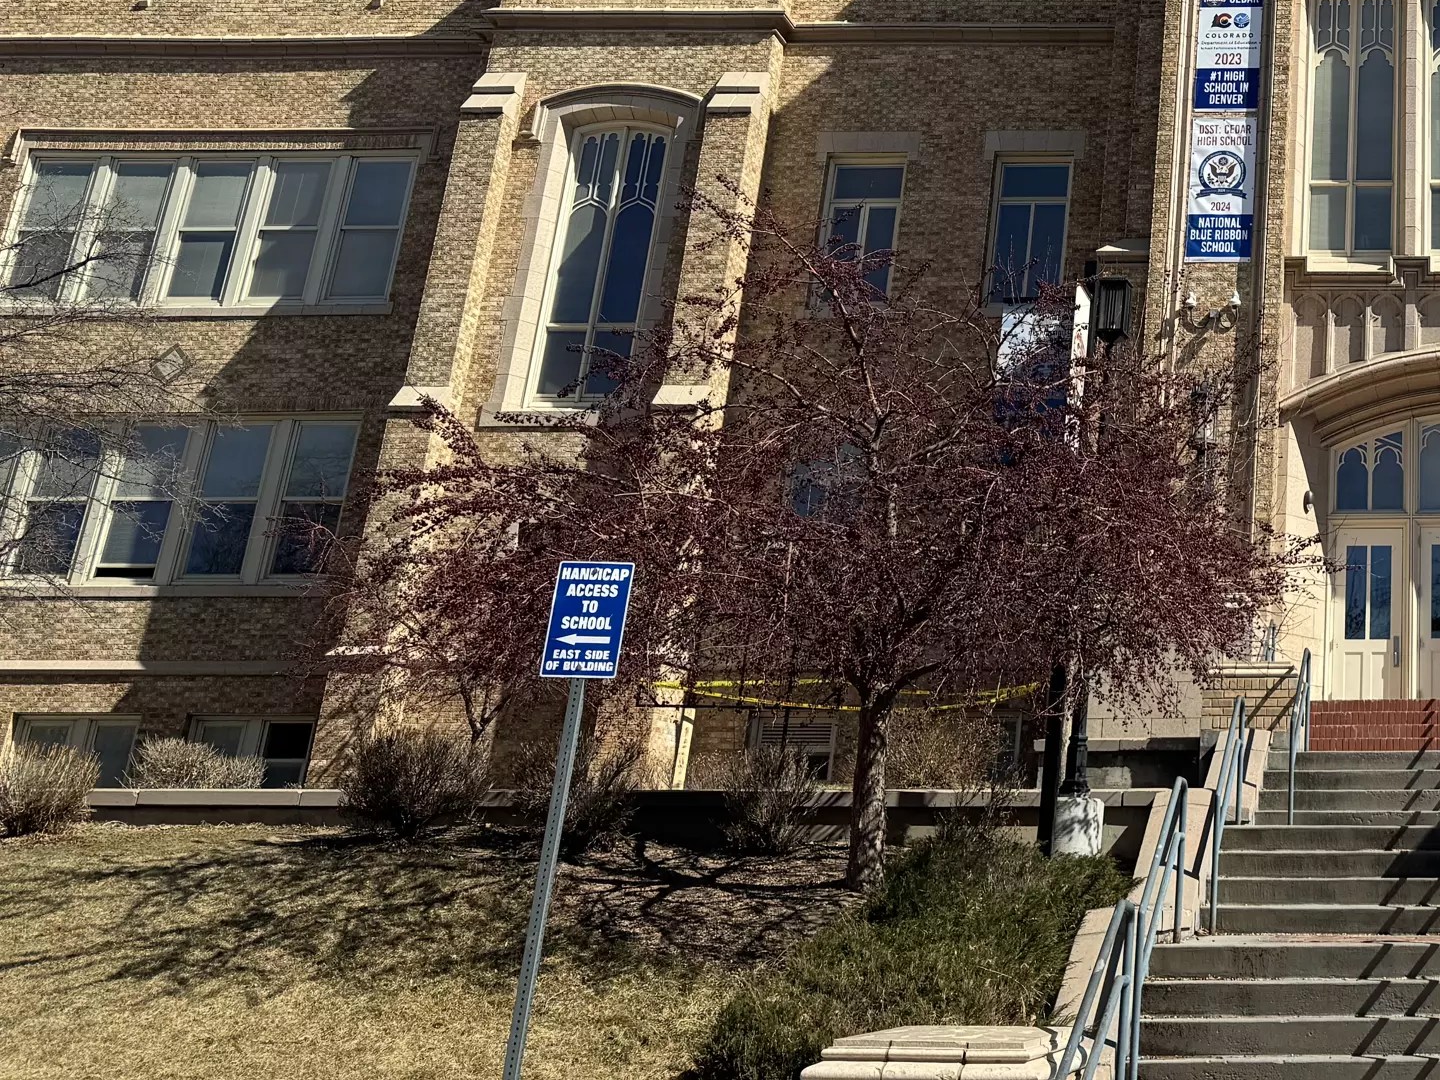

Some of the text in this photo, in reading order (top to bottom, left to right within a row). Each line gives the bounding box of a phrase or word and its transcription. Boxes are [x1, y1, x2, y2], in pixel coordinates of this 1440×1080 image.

[1214, 52, 1242, 65] 2023
[1210, 71, 1245, 81] #1 HIGH
[1204, 82, 1249, 93] SCHOOL IN
[1209, 94, 1244, 105] DENVER
[1199, 125, 1251, 134] DSST: CEDAR
[1196, 136, 1252, 146] HIGH SCHOOL
[1210, 201, 1231, 212] 2024
[1198, 217, 1242, 229] NATIONAL
[1190, 229, 1248, 241] BLUE RIBBON
[1200, 241, 1236, 253] SCHOOL
[561, 567, 630, 581] HANDICAP
[565, 583, 619, 597] ACCESS
[581, 600, 599, 613] TO
[560, 616, 612, 630] SCHOOL
[552, 649, 611, 660] EAST SIDE
[545, 660, 560, 671] OF
